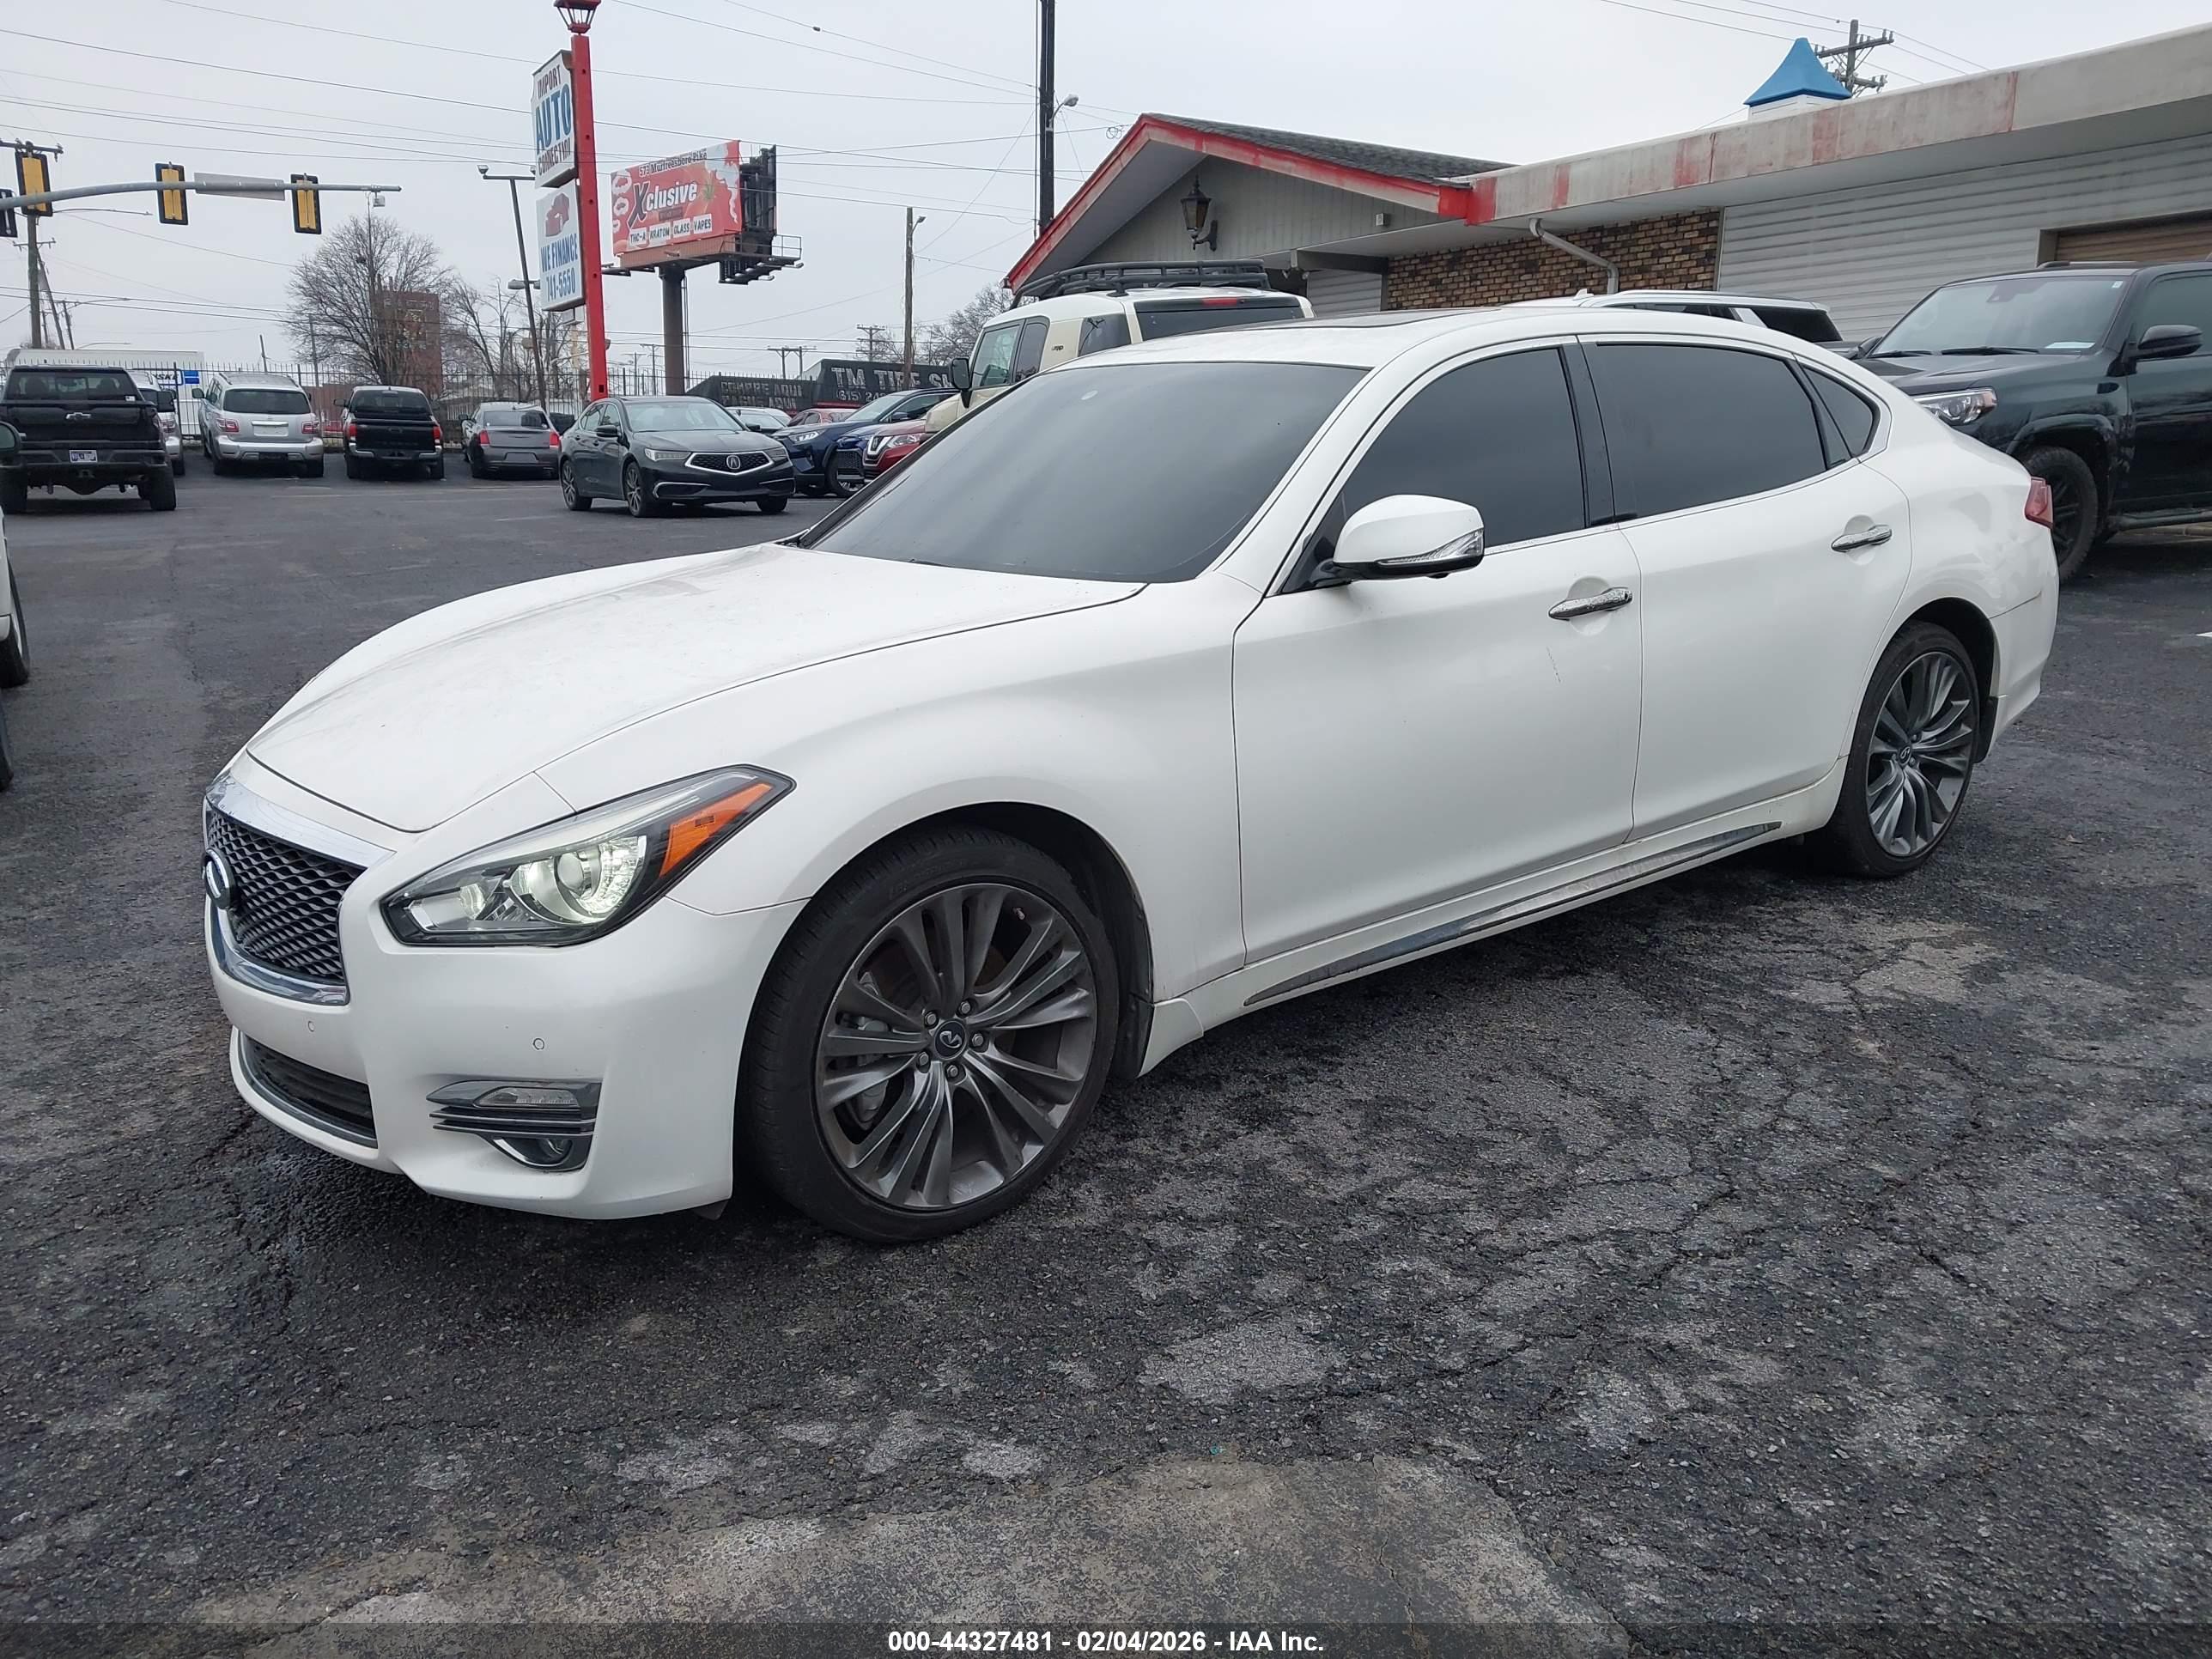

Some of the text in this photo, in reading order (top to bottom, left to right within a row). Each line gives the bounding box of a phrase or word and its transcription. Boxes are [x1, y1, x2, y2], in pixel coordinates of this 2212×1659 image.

[537, 64, 561, 100] IMPORT
[536, 83, 572, 155] AUTO
[639, 149, 708, 177] 573 Murfreesboro Pike
[627, 180, 698, 229] Xclusive
[629, 230, 646, 244] THC-A
[649, 225, 670, 240] KRATOM
[693, 217, 711, 232] VAPES
[540, 233, 578, 273] WE FINANCE
[831, 367, 866, 389] TM
